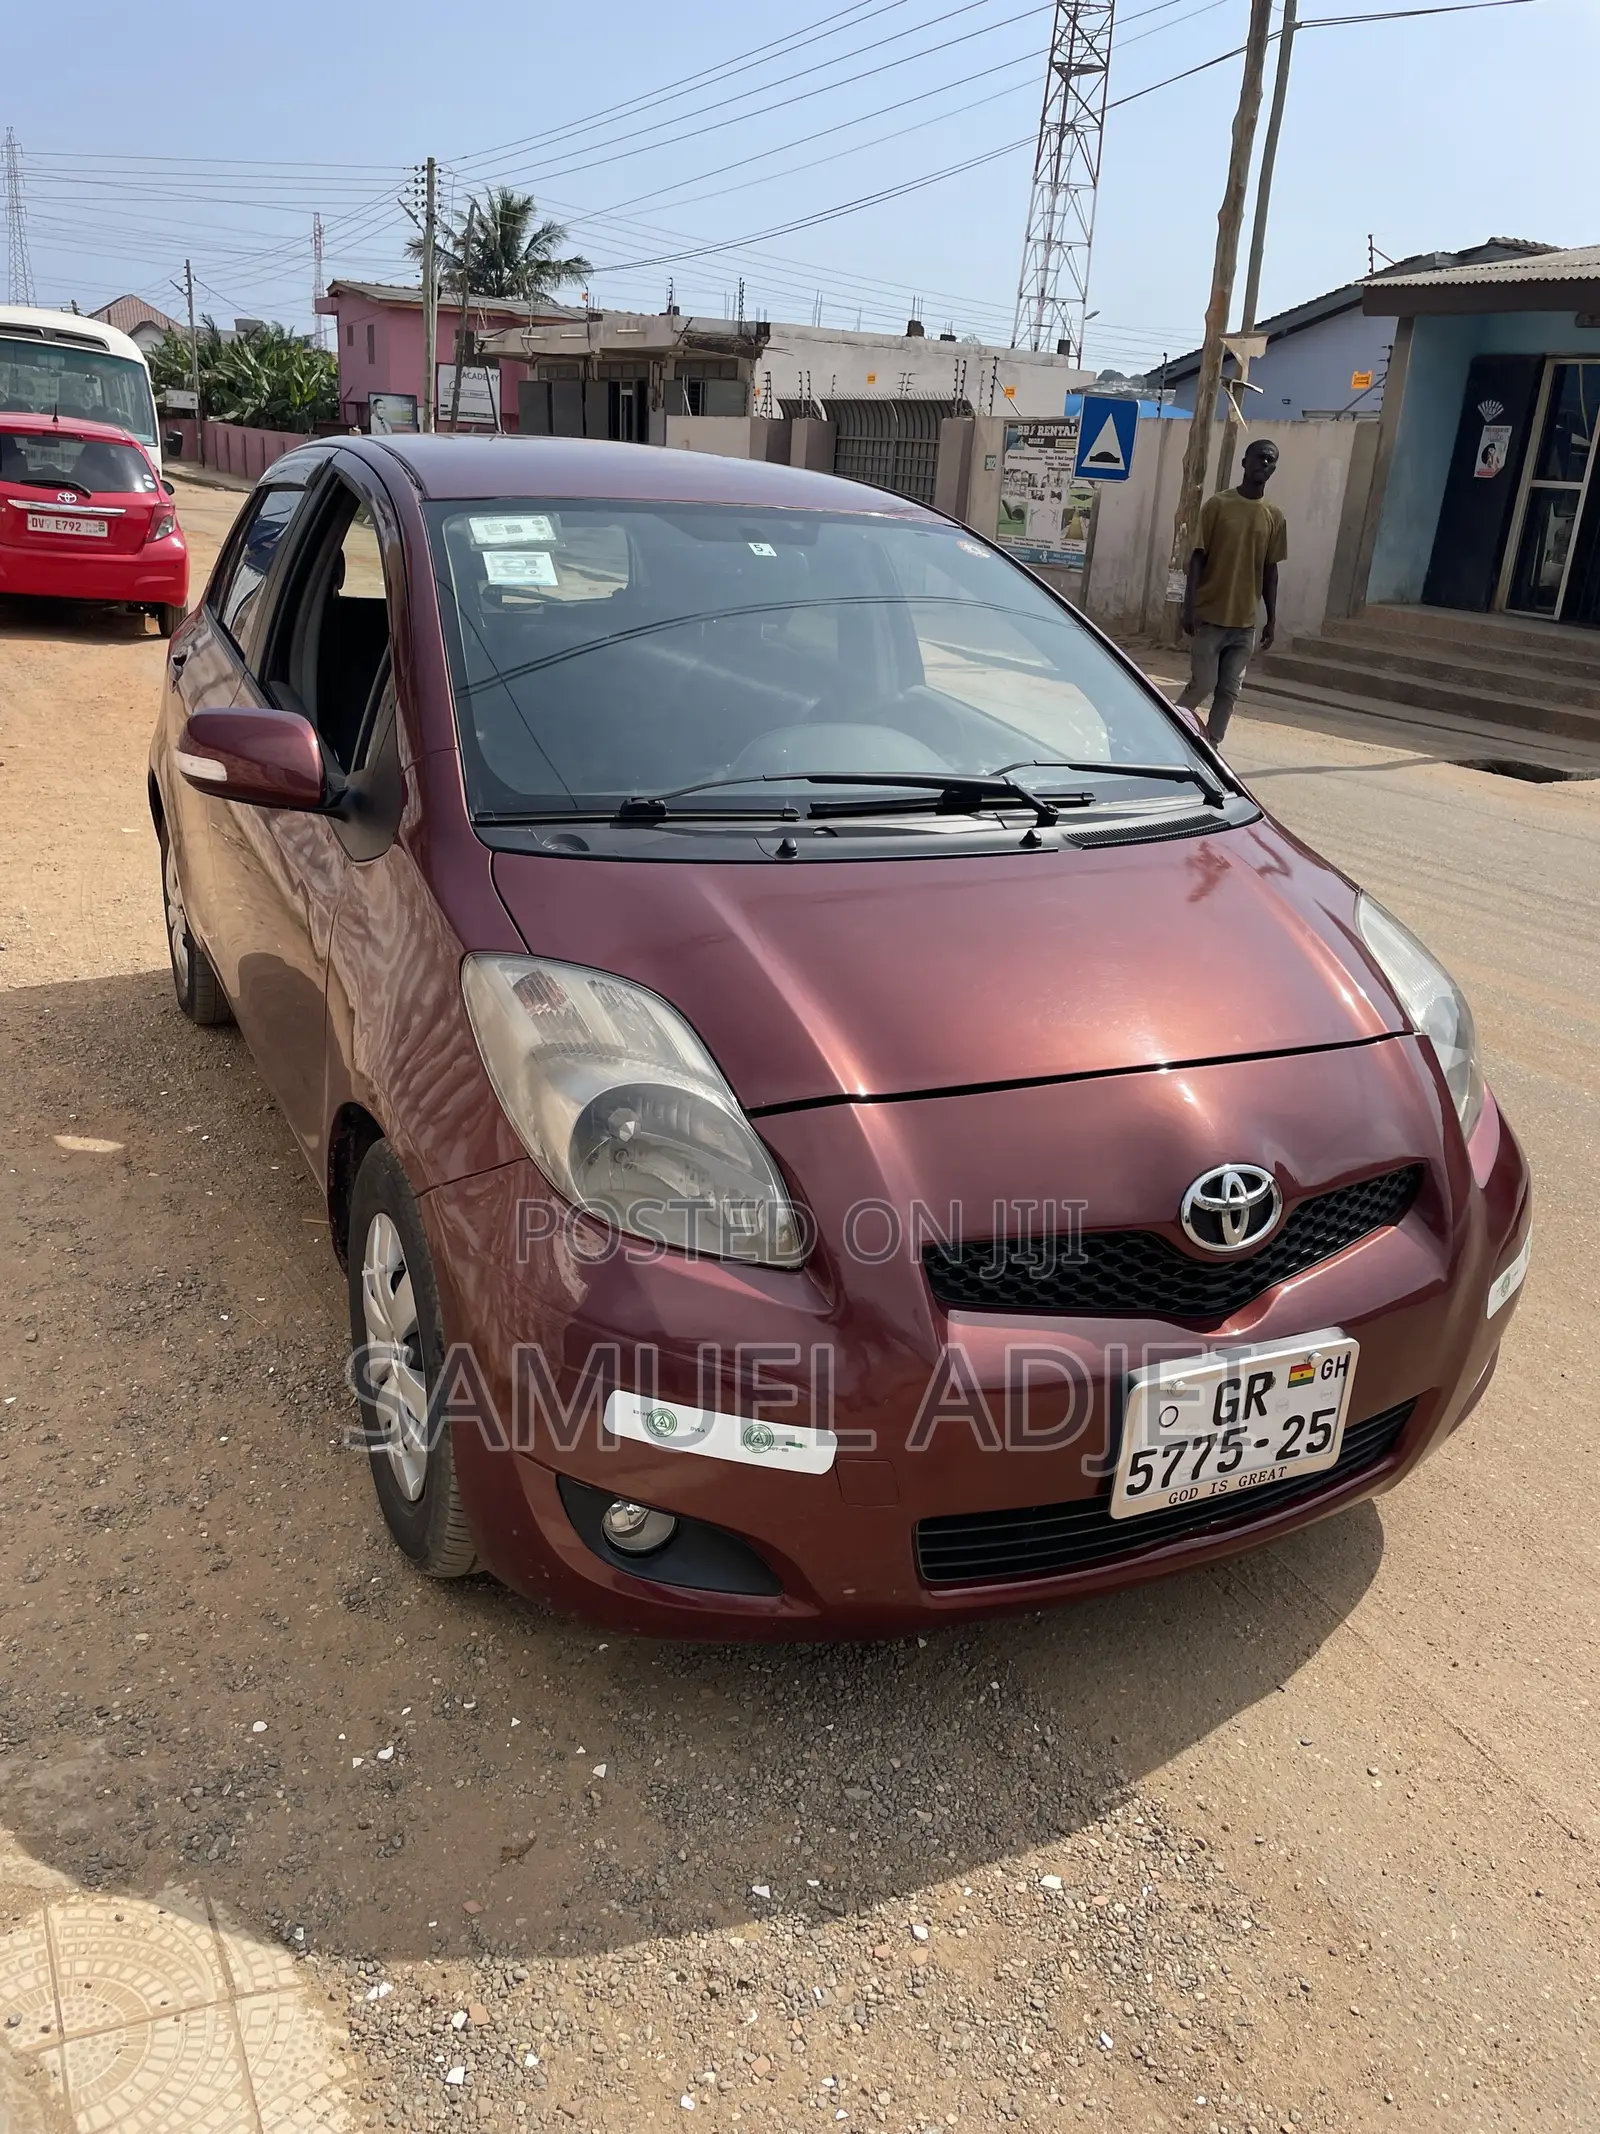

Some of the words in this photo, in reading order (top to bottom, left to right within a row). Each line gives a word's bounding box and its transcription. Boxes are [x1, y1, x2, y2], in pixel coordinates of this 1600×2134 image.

[1037, 424, 1078, 437] RENTAL
[31, 517, 45, 528] DV
[55, 519, 82, 532] E792
[1212, 1371, 1274, 1426] GR
[1320, 1355, 1348, 1381] GH
[1126, 1407, 1337, 1497] 5775-25
[1168, 1486, 1199, 1505] GOD
[1210, 1479, 1228, 1494] IS
[1238, 1465, 1289, 1488] GREAT
